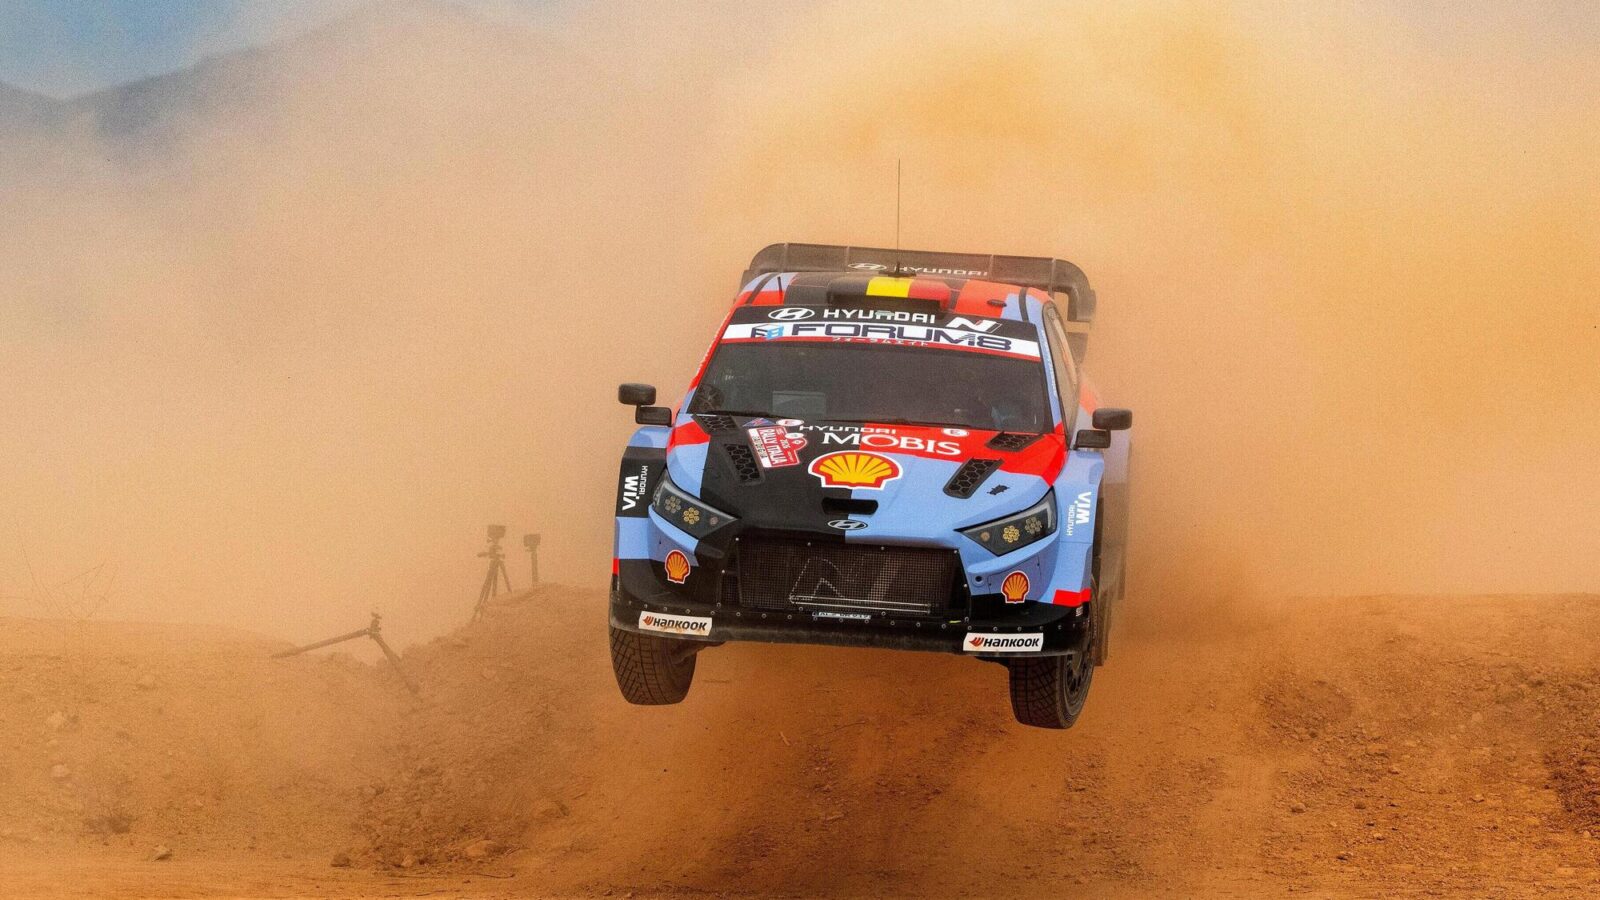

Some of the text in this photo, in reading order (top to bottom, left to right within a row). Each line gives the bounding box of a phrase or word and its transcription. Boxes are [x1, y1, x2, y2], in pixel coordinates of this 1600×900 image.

[893, 265, 988, 276] HYUNDAI
[823, 308, 936, 324] HYUNDAI
[792, 323, 1012, 351] FORUM8
[799, 425, 896, 434] HYUNDAI
[822, 432, 961, 456] MOBIS
[638, 465, 649, 495] HYUNDAI
[1066, 504, 1077, 537] HYUNDAI
